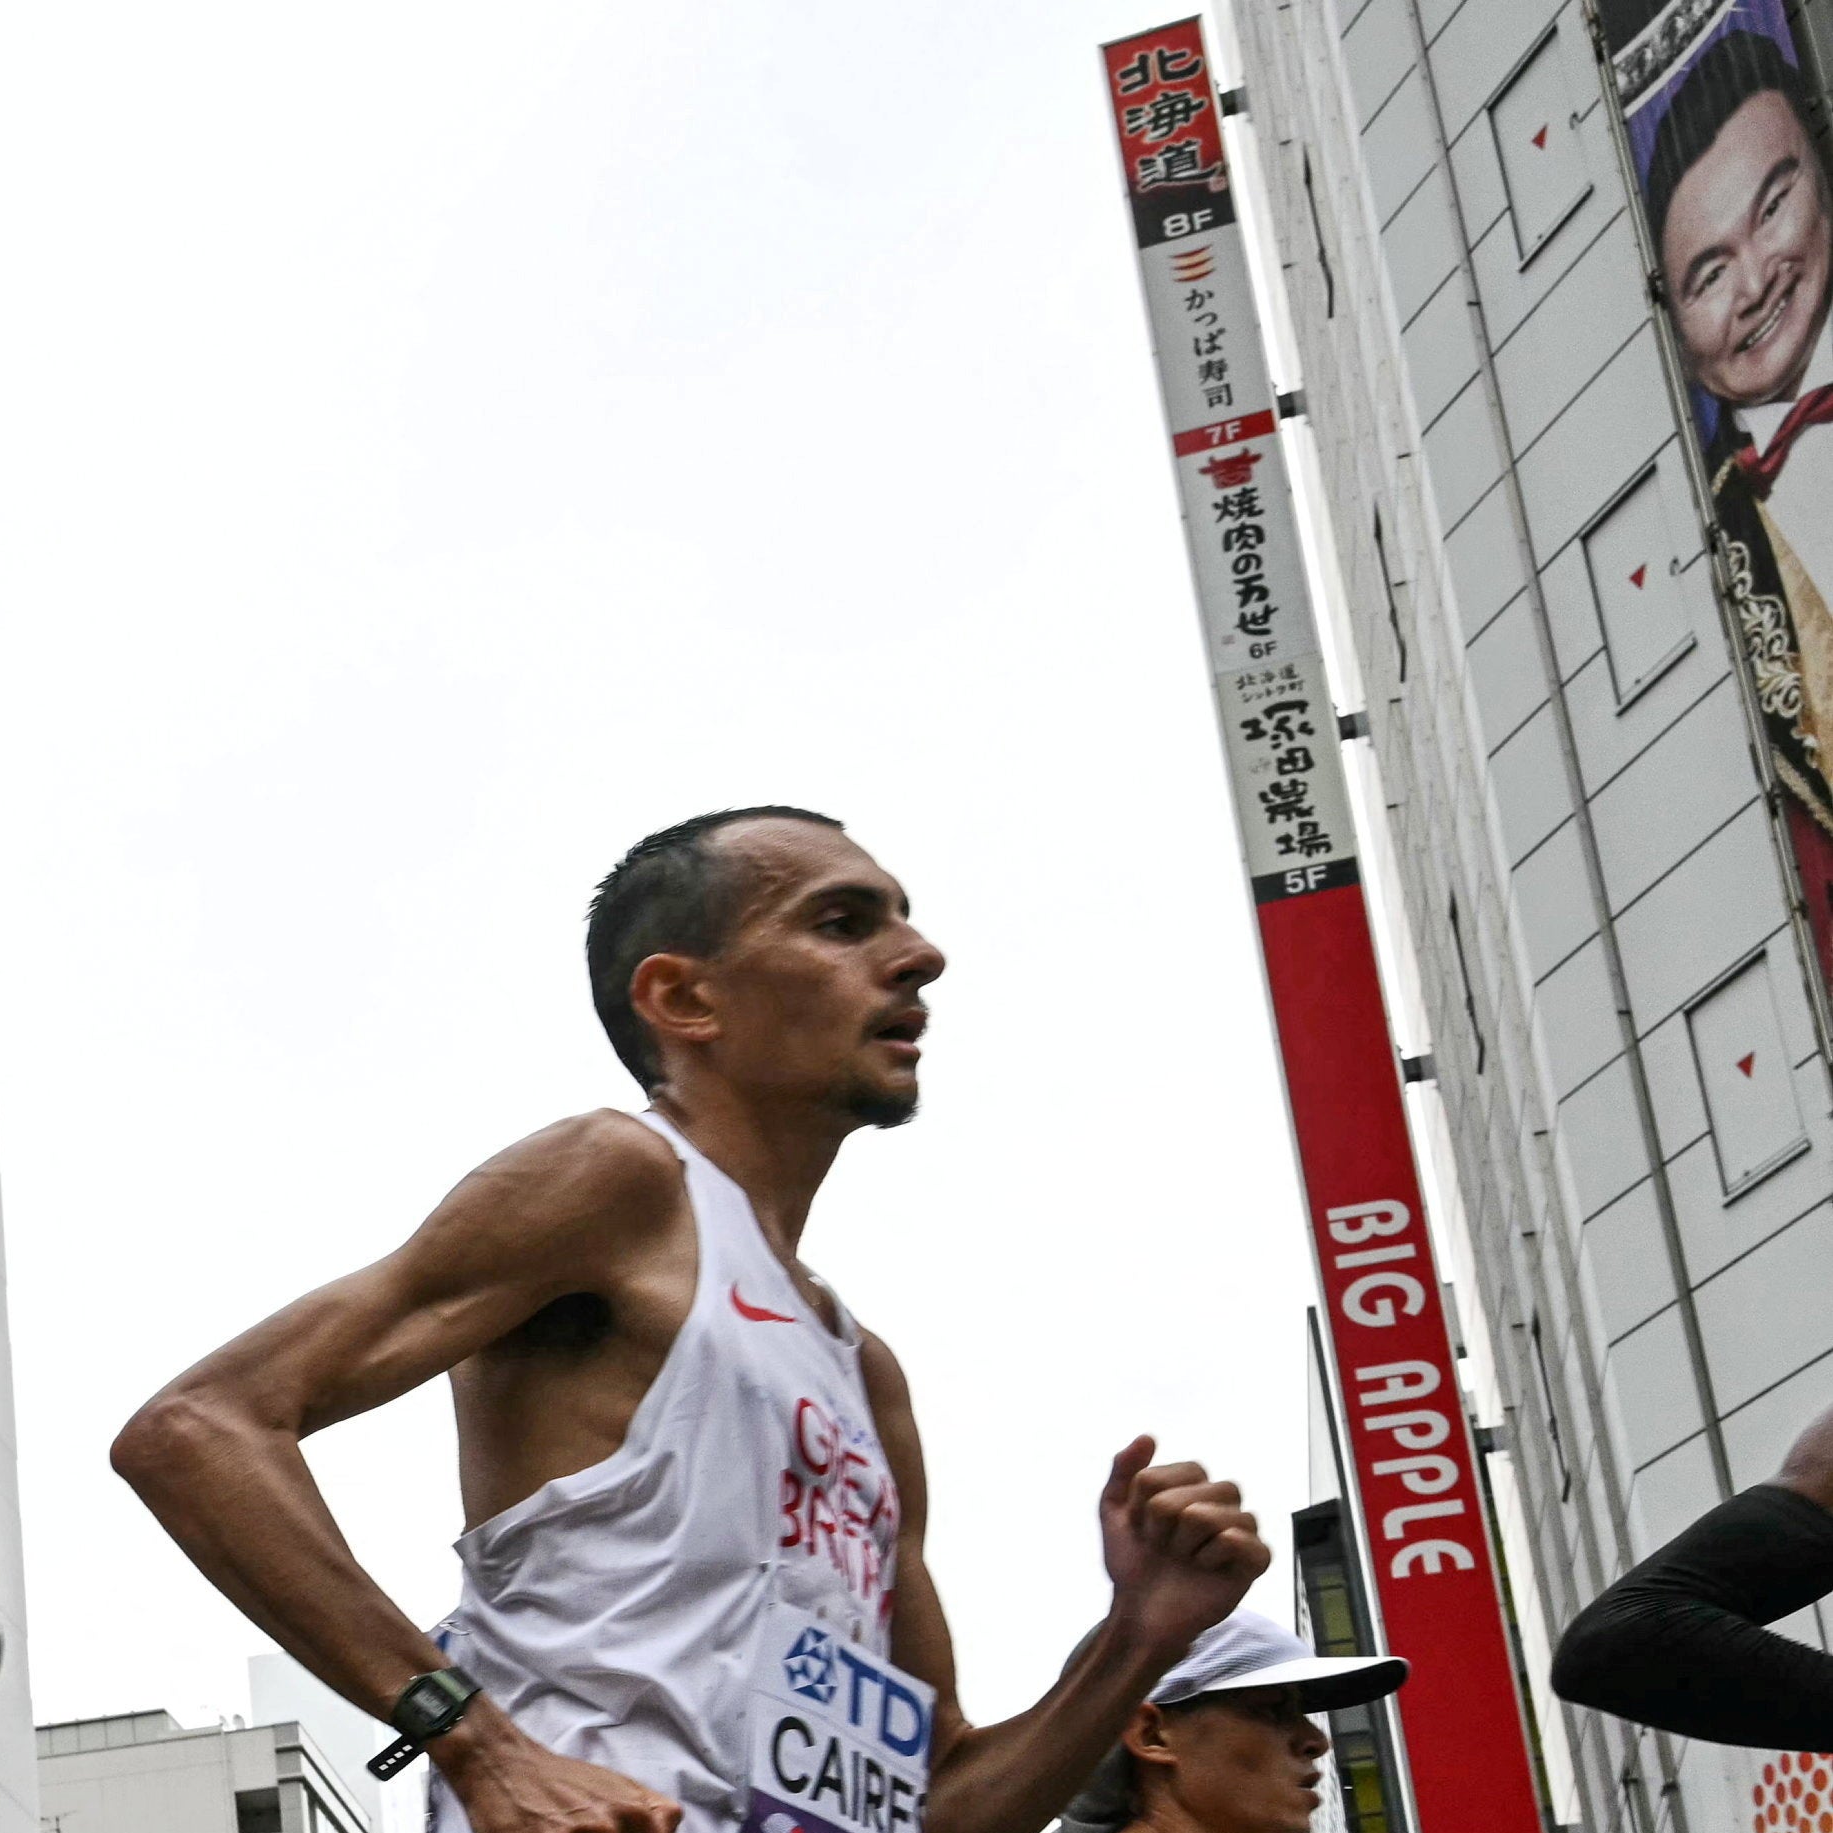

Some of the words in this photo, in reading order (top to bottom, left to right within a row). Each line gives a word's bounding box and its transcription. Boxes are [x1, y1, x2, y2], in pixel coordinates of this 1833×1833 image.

[1118, 46, 1225, 192] 北海道
[1163, 207, 1214, 238] 8F
[1184, 287, 1235, 409] かっぱ寿司
[1205, 423, 1241, 445] 7F
[1211, 486, 1280, 637] 焼肉の万世
[1236, 662, 1299, 691] 北海道
[1249, 641, 1277, 660] 6F
[1284, 865, 1327, 894] 5F
[1327, 1198, 1426, 1327] BIG
[1354, 1359, 1475, 1580] APPLE
[836, 1645, 927, 1758] TD
